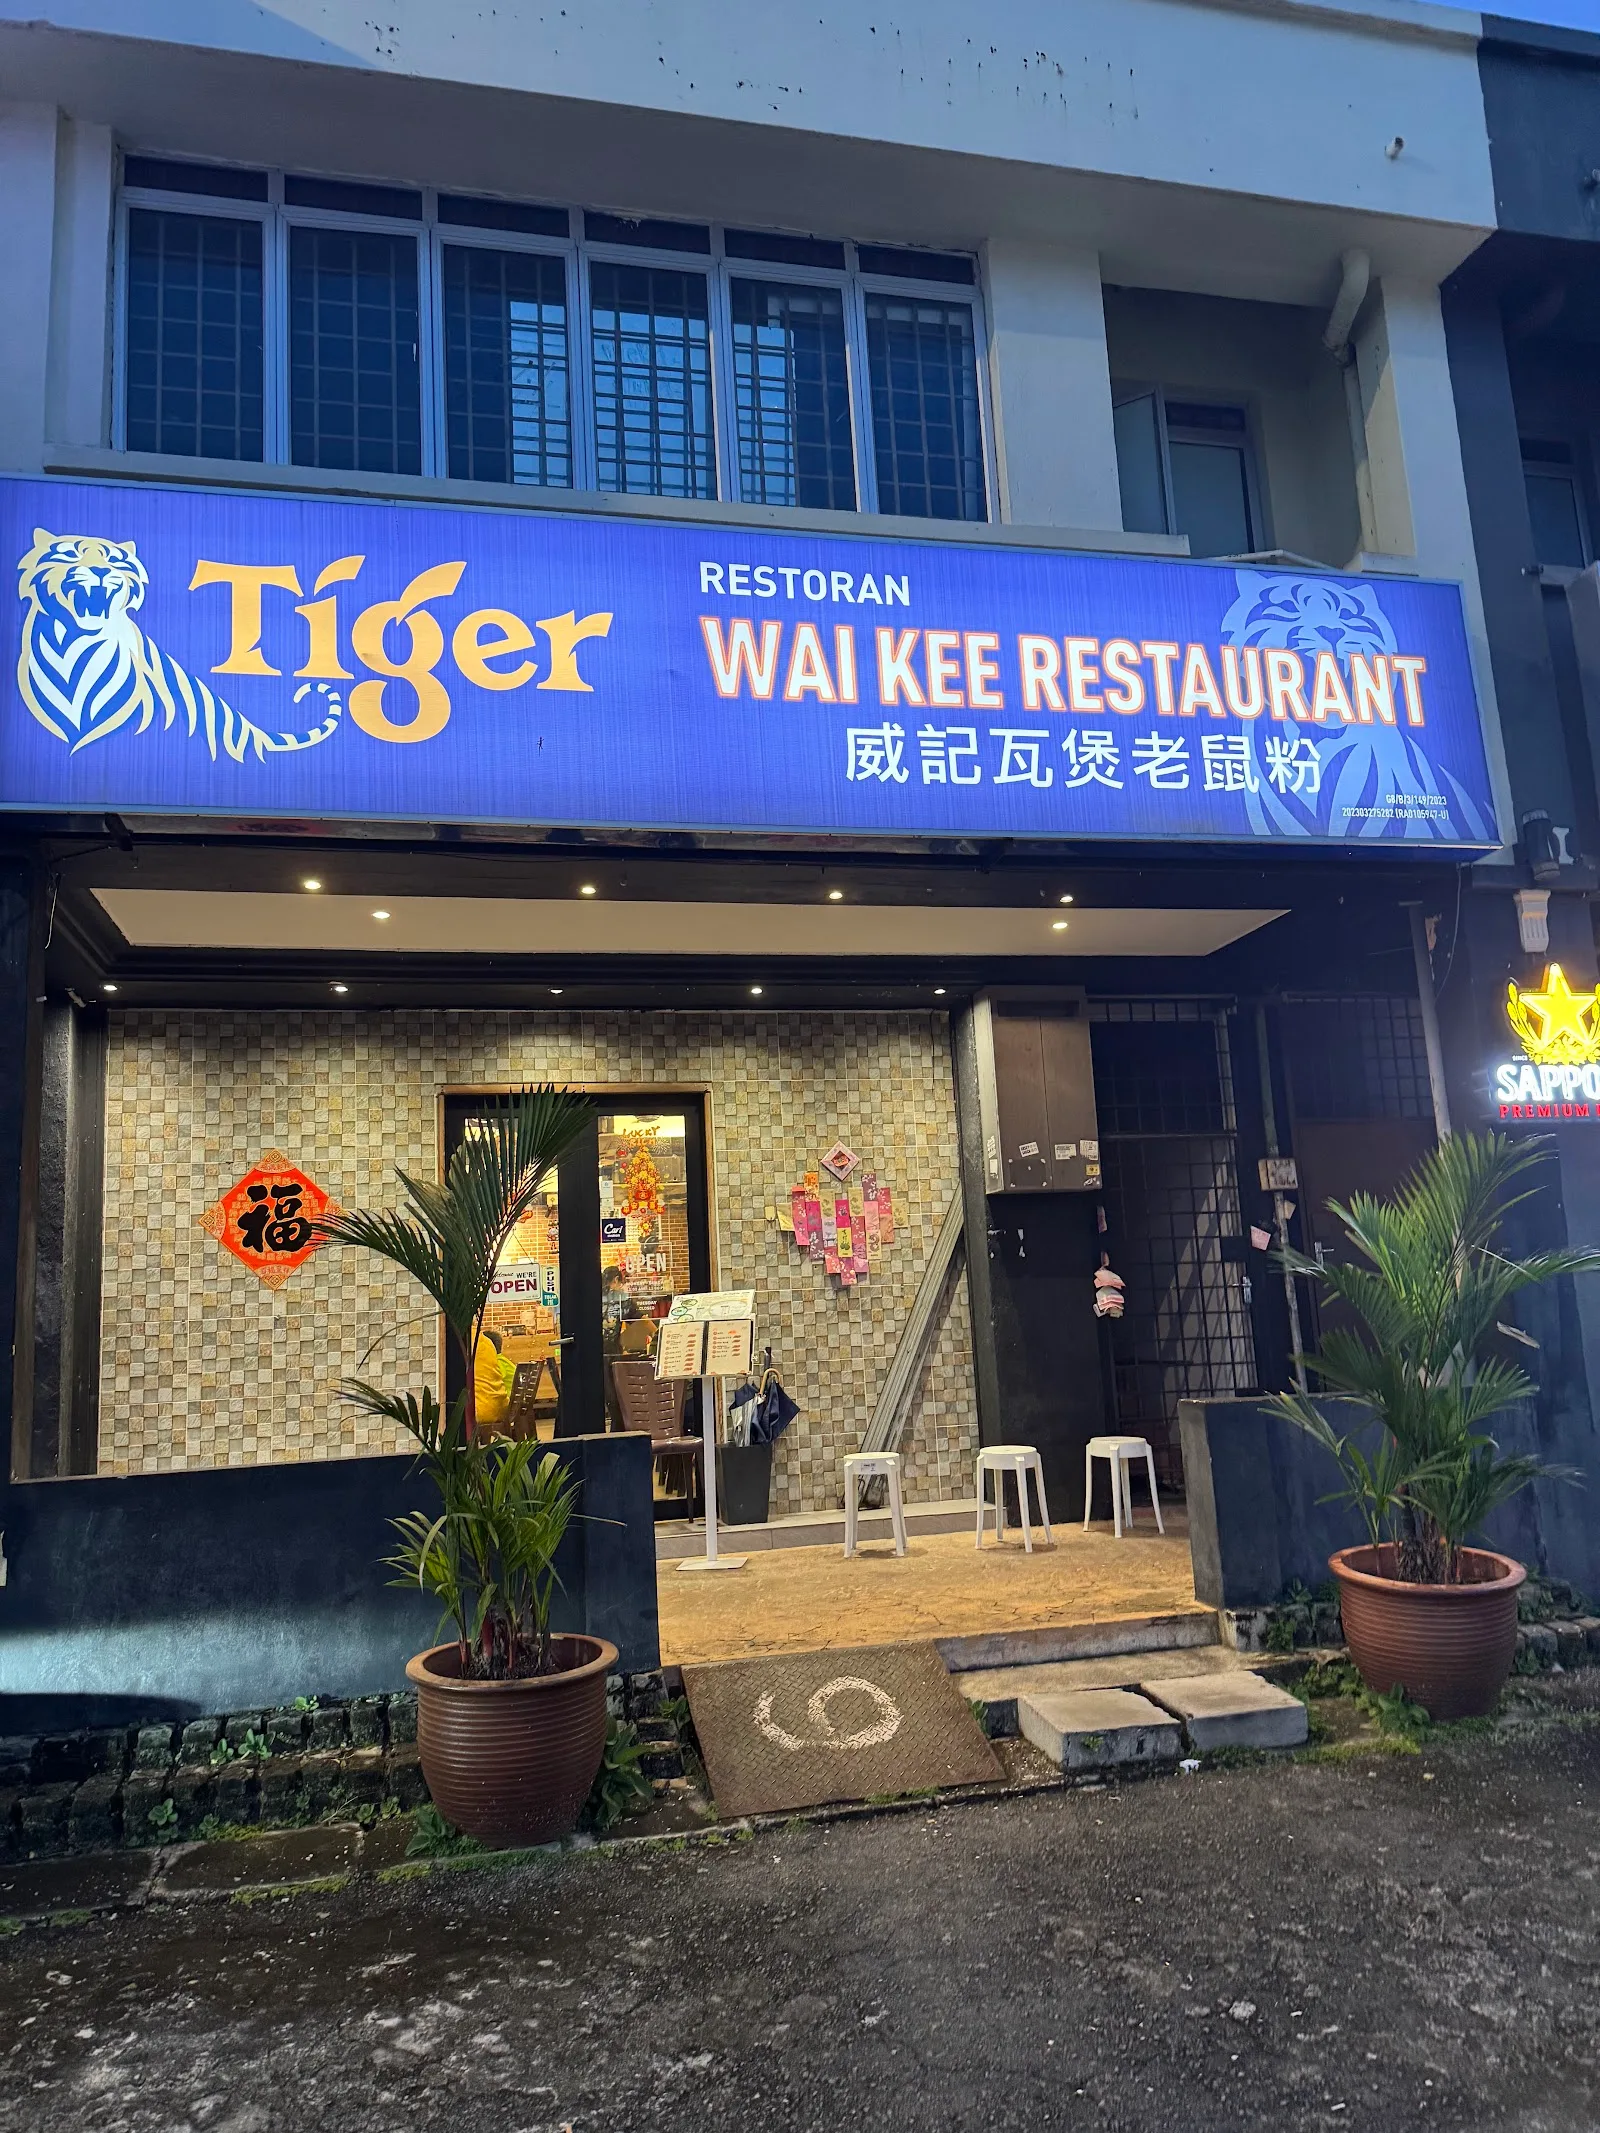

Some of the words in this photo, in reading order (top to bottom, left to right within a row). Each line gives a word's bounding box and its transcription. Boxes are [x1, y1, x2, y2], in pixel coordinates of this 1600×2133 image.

[700, 562, 910, 606] RESTORAN
[188, 555, 613, 743] Tiger
[700, 616, 857, 703] WAI
[875, 627, 1004, 709] KEE
[1018, 634, 1427, 727] RESTAURANT
[846, 722, 1321, 794] 威記瓦煲老鼠粉
[622, 1126, 660, 1138] LUCKY
[1499, 1103, 1590, 1118] PREMIUM
[237, 1183, 313, 1253] 福
[625, 1252, 666, 1273] OPEN
[490, 1279, 537, 1294] OPEN
